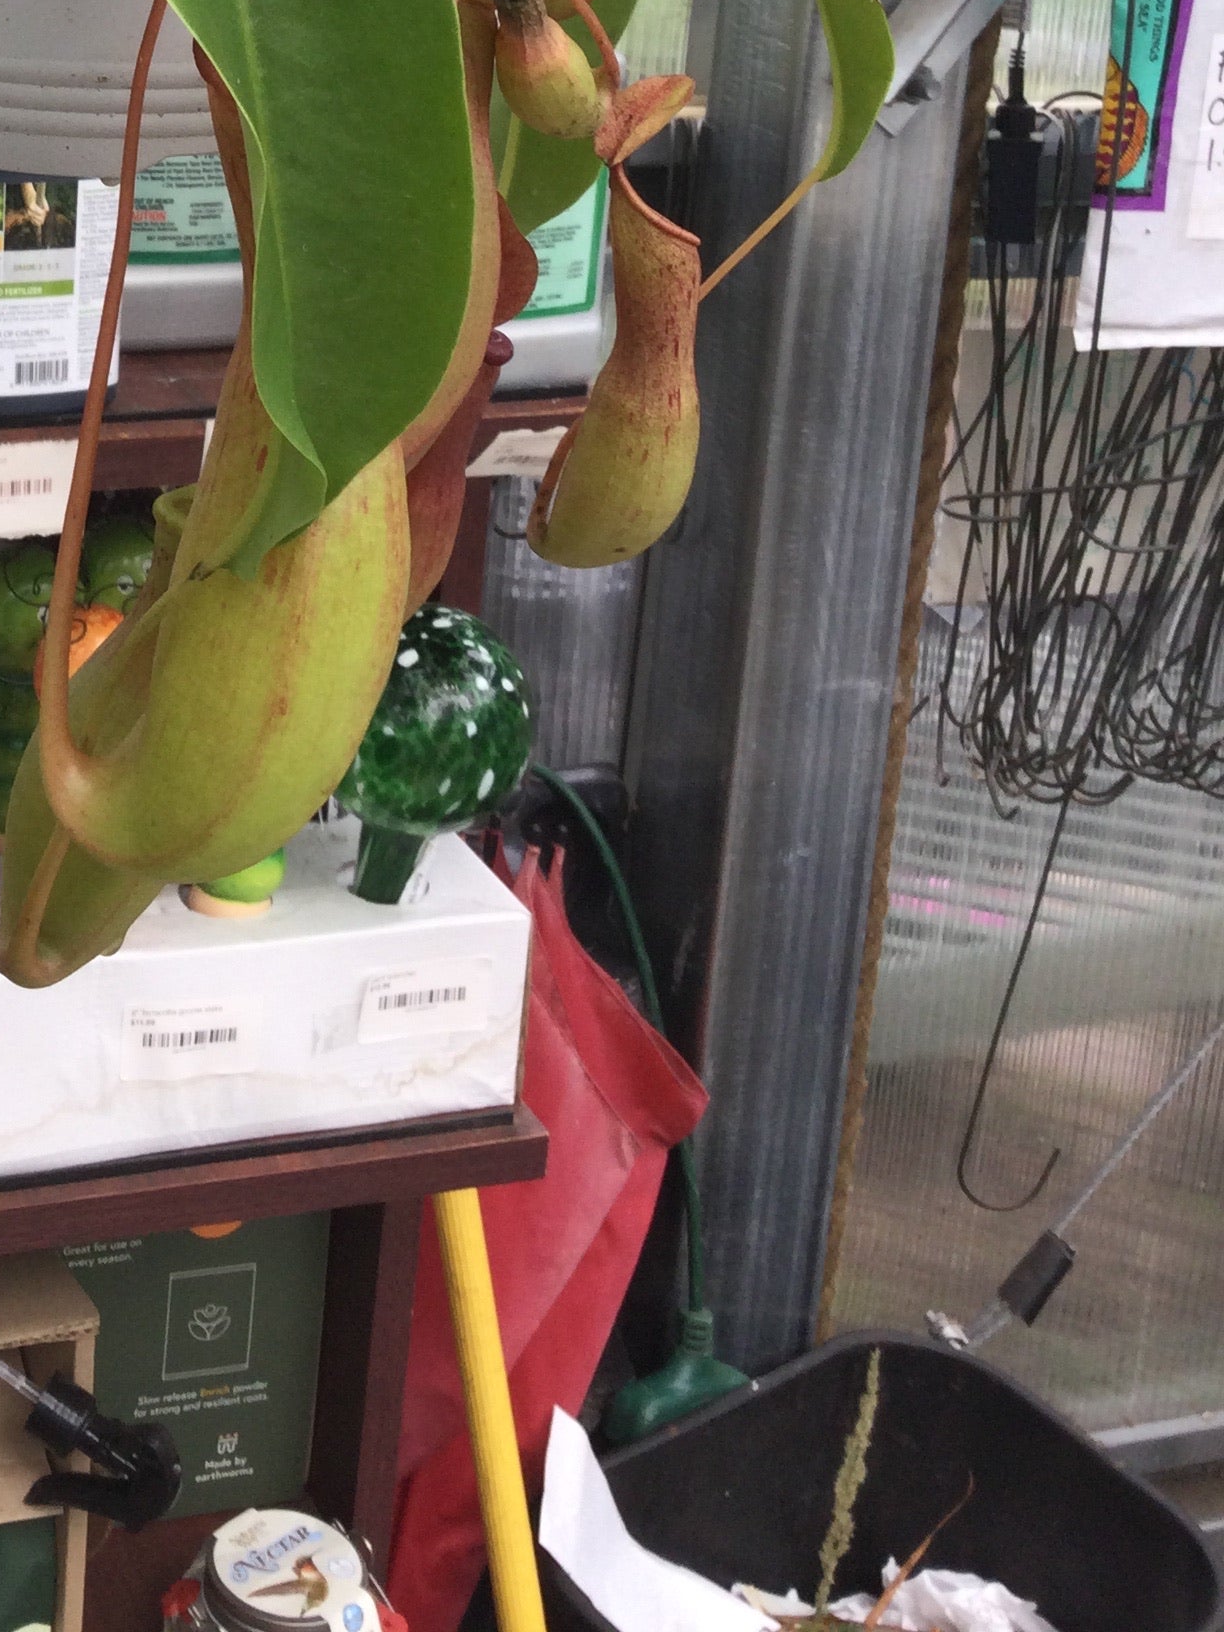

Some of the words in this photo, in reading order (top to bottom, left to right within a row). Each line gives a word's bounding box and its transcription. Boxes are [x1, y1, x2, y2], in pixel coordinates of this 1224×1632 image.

[1148, 15, 1165, 63] THINGS
[5, 286, 43, 296] FERTILIZER
[63, 1242, 93, 1257] Great
[94, 1240, 108, 1252] for
[110, 1241, 128, 1252] use
[130, 1239, 143, 1248] on
[67, 1257, 95, 1268] every
[137, 1394, 160, 1406] Slow
[162, 1390, 197, 1403] release
[233, 1380, 269, 1396] powder
[133, 1407, 147, 1418] for
[149, 1405, 181, 1417] strong
[183, 1401, 201, 1412] and
[203, 1395, 241, 1409] resilient
[204, 1460, 233, 1469] Made
[234, 1456, 247, 1468] by
[194, 1467, 254, 1483] earthworms
[231, 1524, 311, 1583] NECTAR
